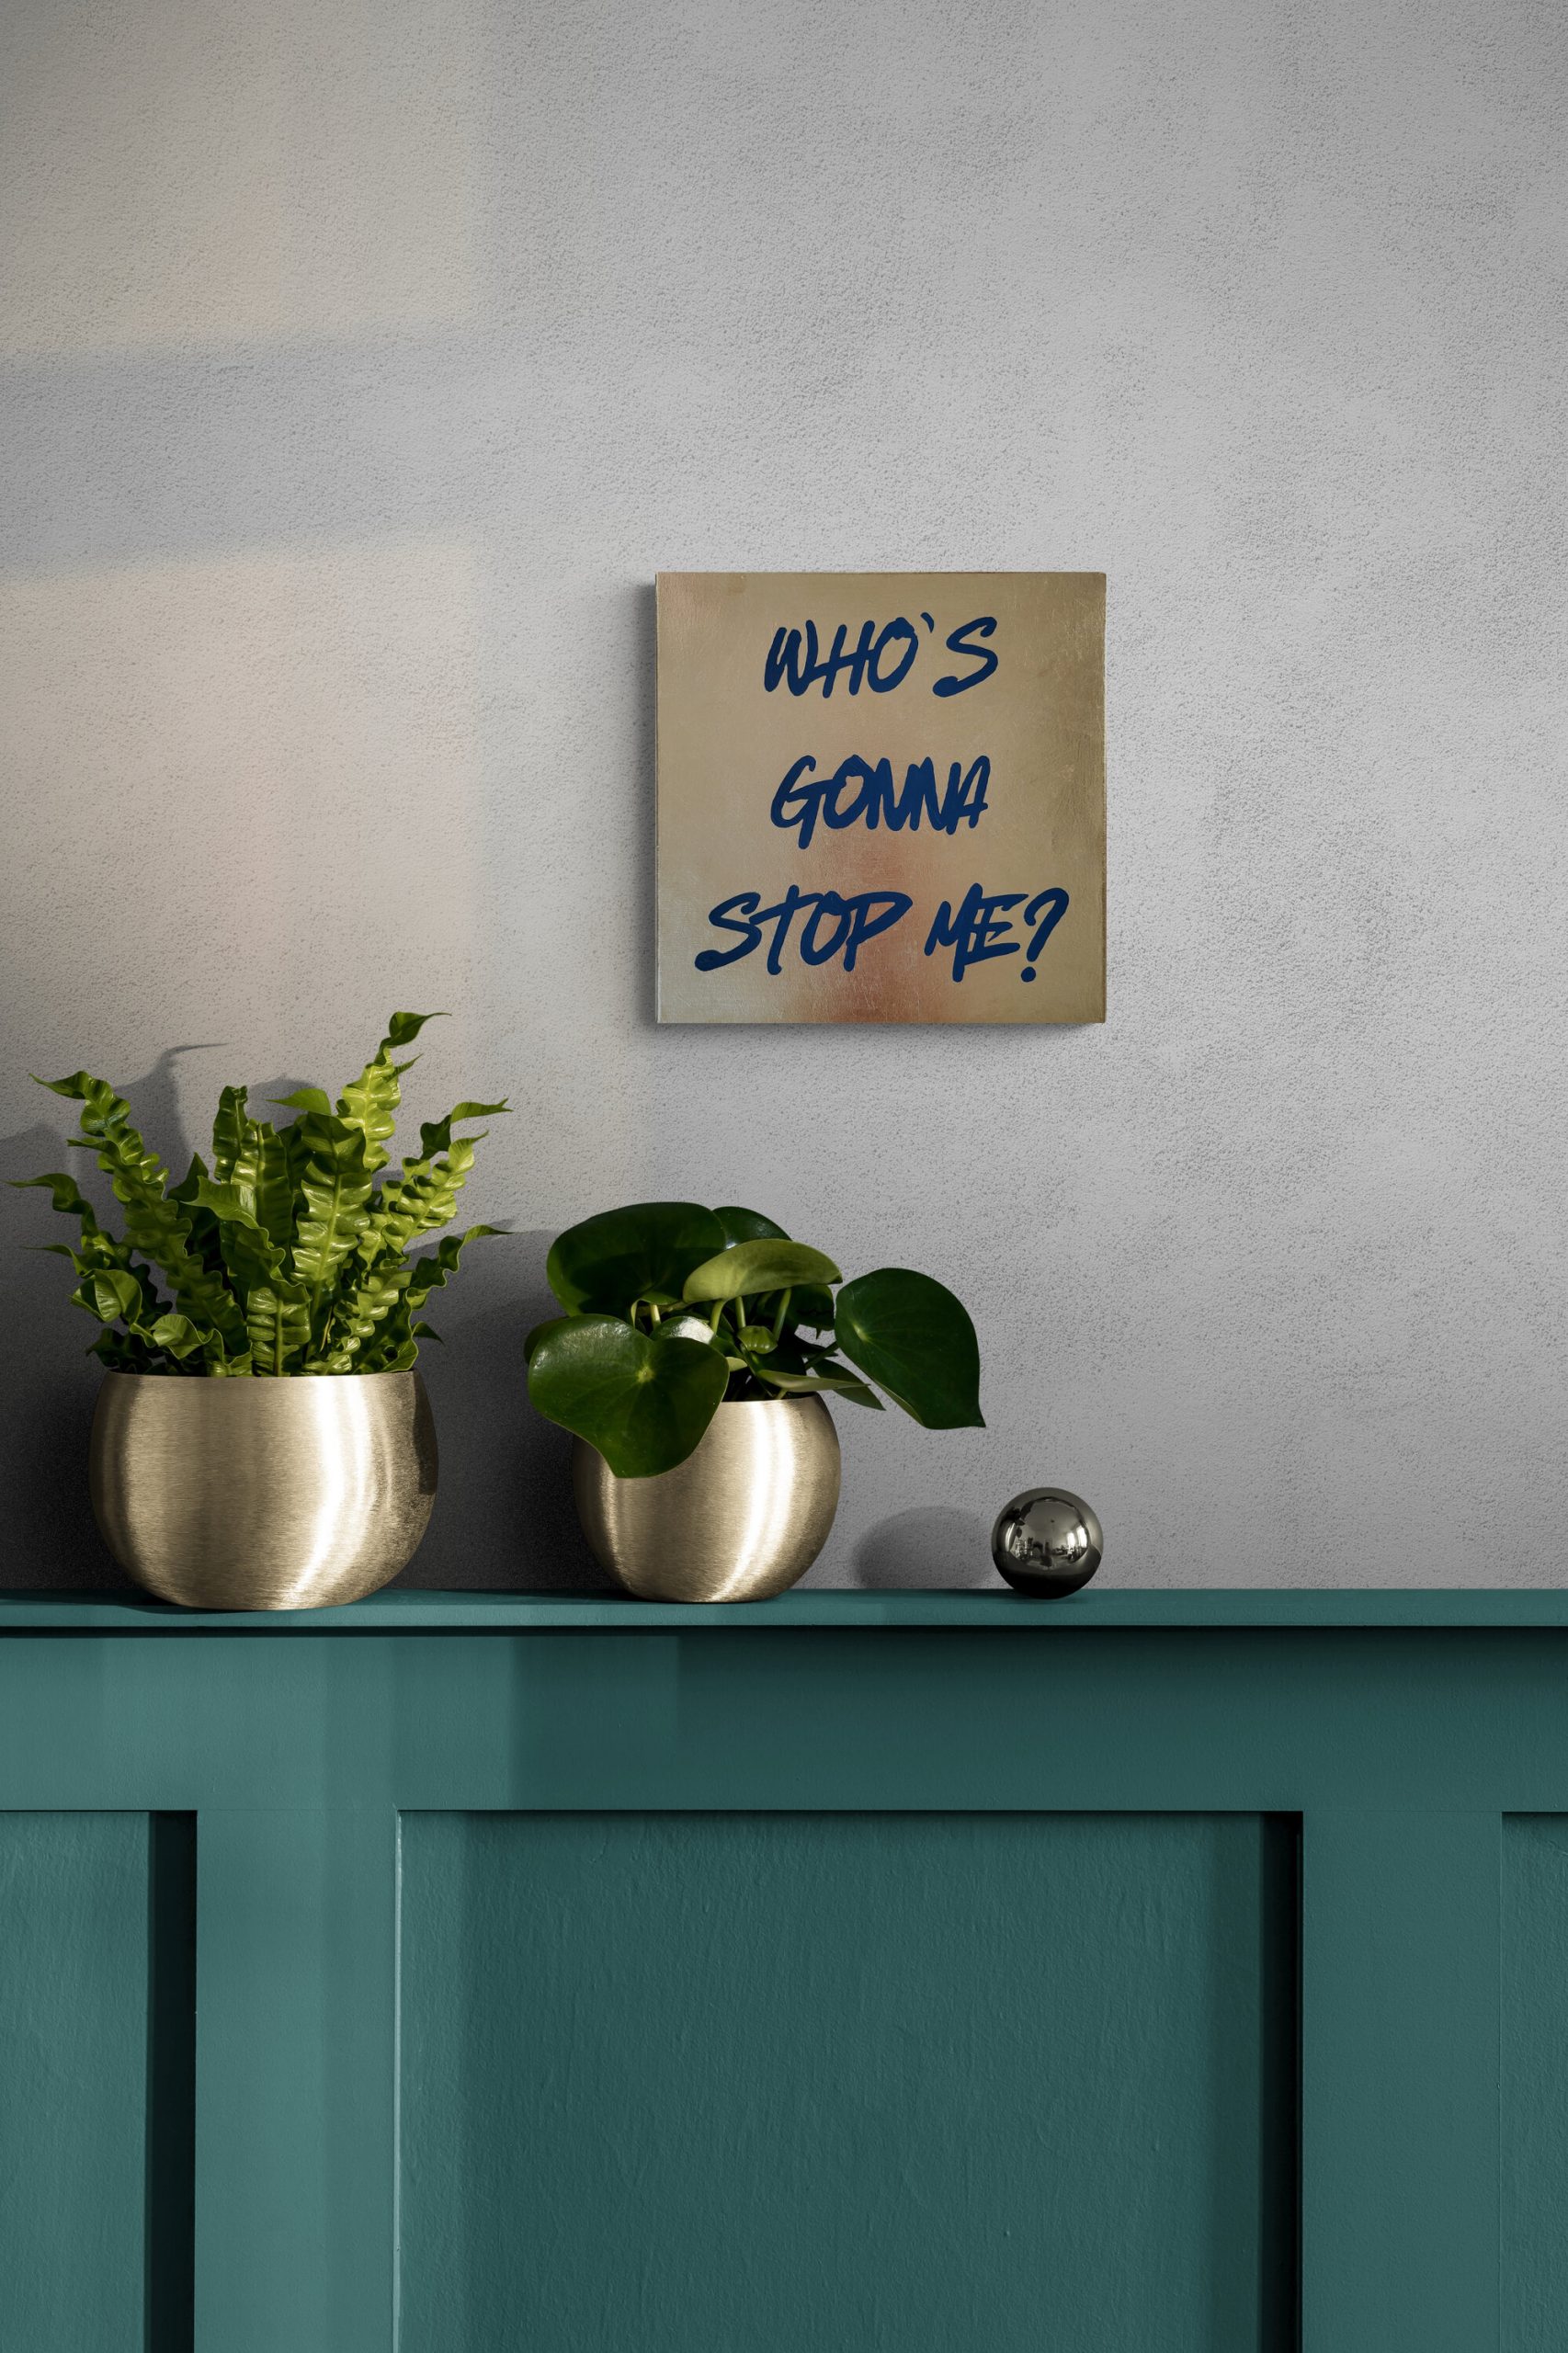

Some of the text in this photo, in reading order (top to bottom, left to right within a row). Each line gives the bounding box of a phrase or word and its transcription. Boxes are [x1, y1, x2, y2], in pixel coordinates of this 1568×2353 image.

[764, 612, 999, 699] WHO'S
[770, 755, 991, 849] GONNA
[694, 882, 1070, 983] STOP ME?
